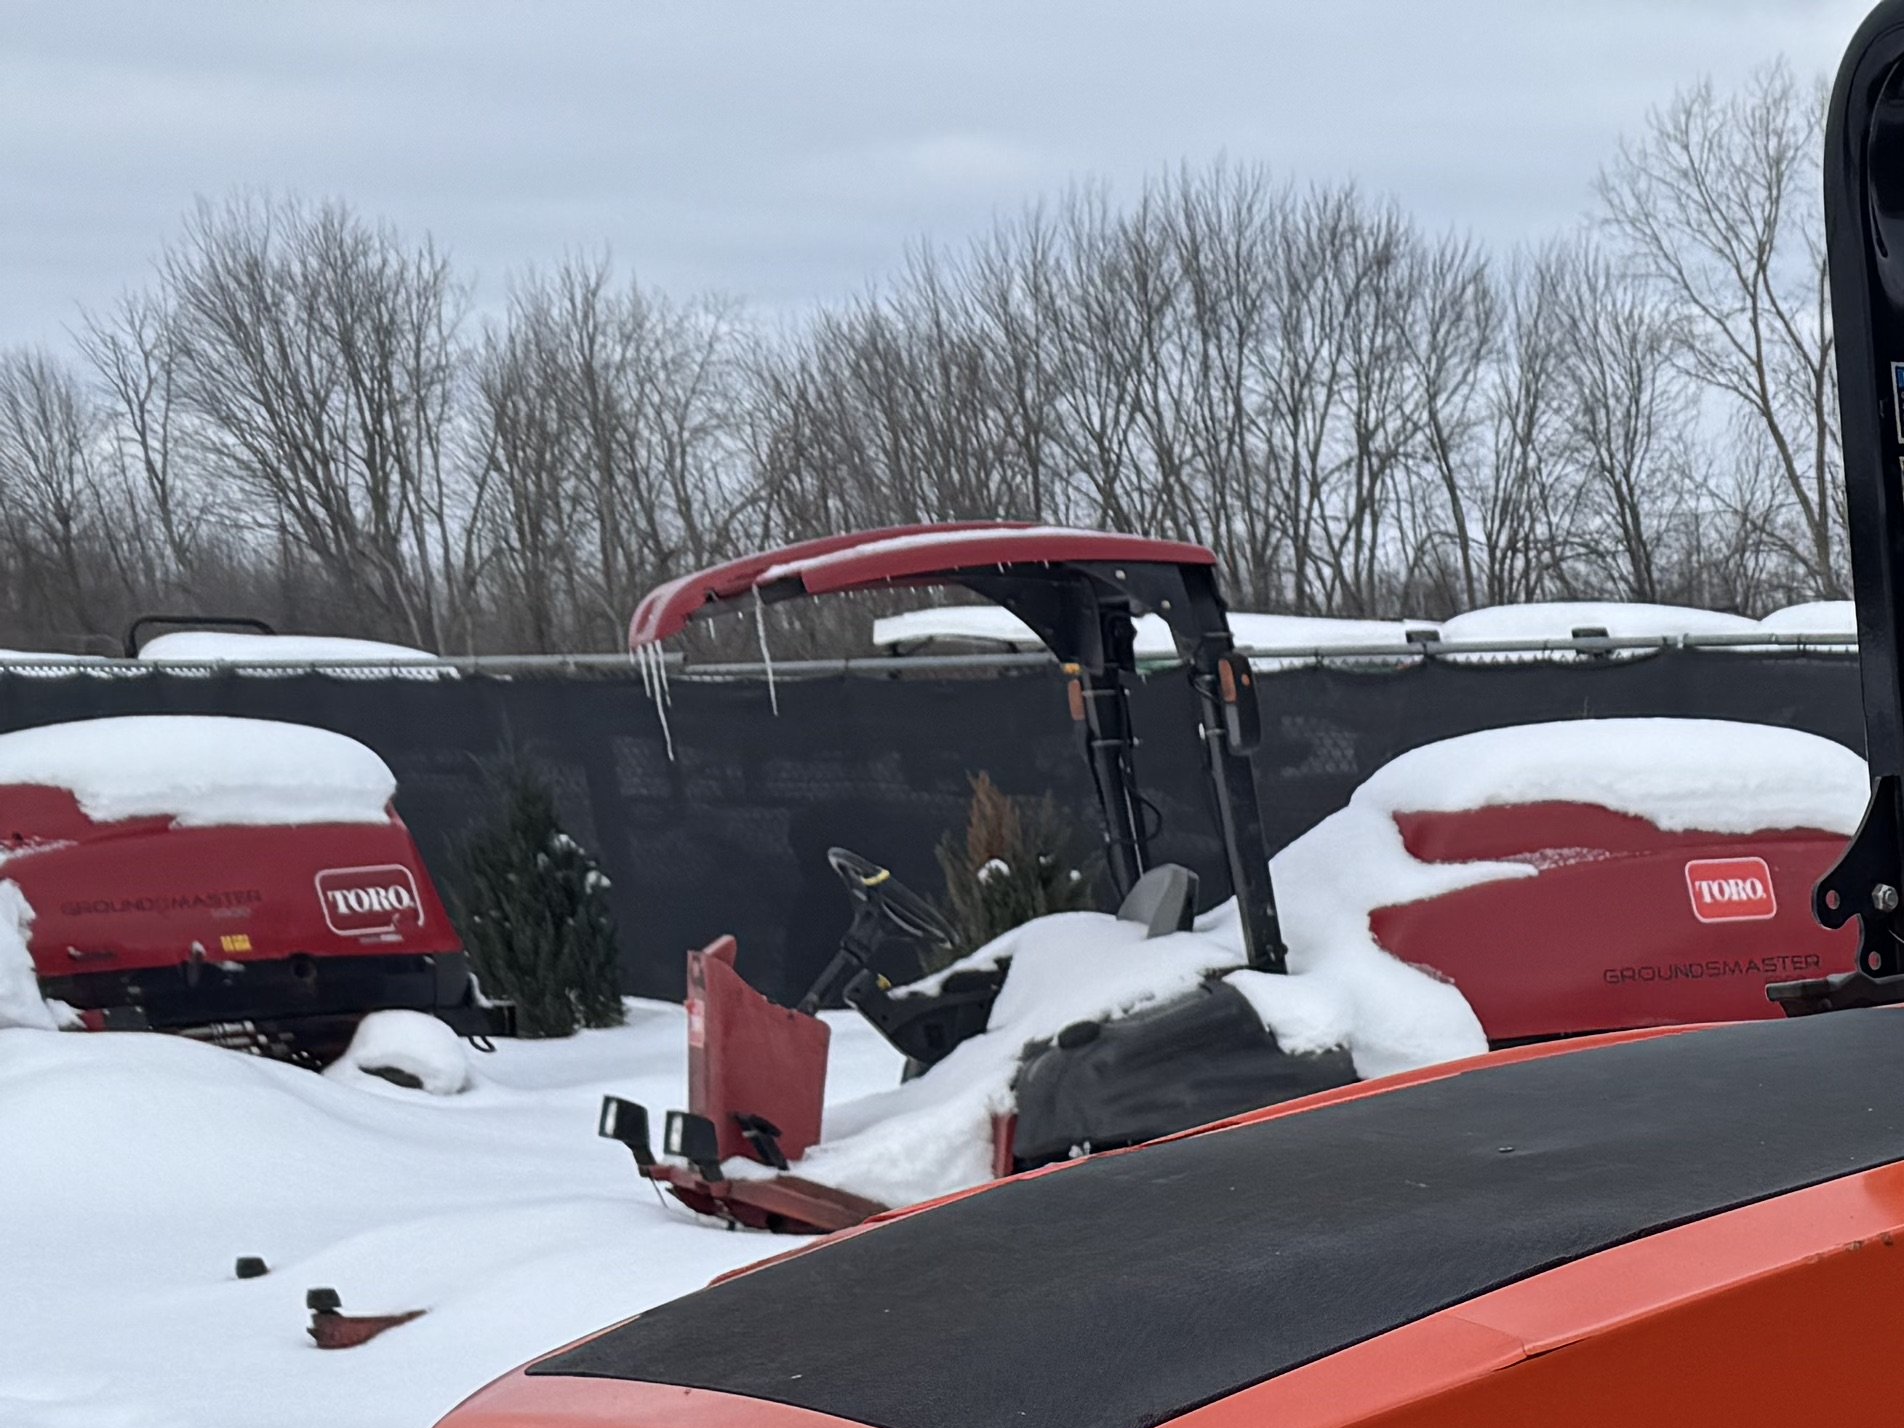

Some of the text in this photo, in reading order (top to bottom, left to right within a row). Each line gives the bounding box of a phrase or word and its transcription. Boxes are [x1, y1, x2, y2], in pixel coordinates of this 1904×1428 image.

[327, 884, 411, 914] TORO
[1694, 878, 1764, 904] TORO
[1603, 954, 1821, 984] GROUNDSMASTER
